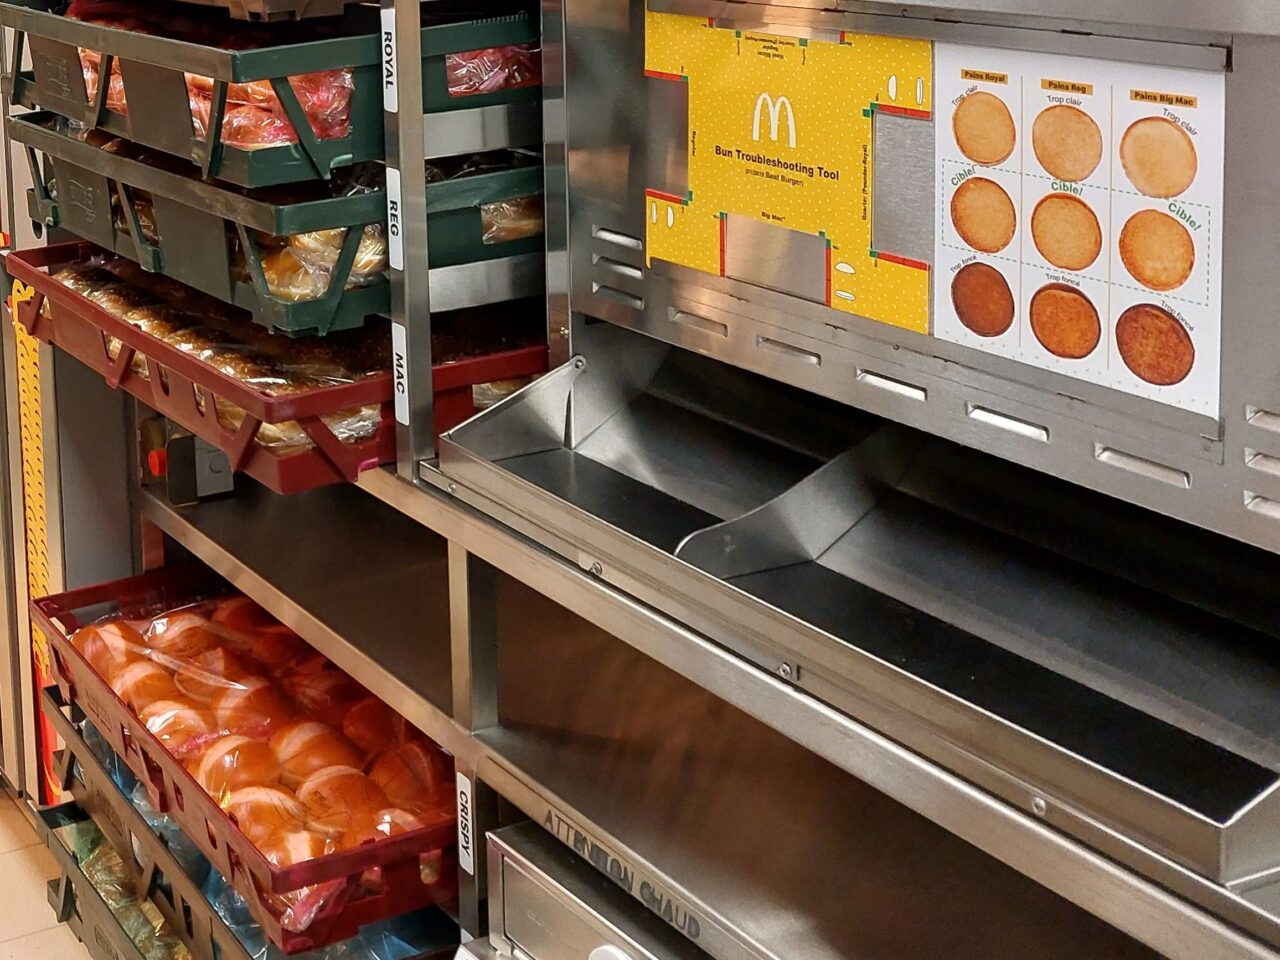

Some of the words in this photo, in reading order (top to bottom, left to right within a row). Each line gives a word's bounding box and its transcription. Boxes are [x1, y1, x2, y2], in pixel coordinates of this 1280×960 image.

[384, 31, 394, 90] ROYAL
[964, 70, 984, 80] Pains
[985, 73, 1005, 83] Royal
[1048, 81, 1070, 91] Pains
[1072, 84, 1086, 94] Reg
[951, 93, 965, 107] Trop
[965, 84, 978, 96] clair
[1047, 95, 1065, 105] Trop
[1065, 97, 1082, 107] clair
[1134, 91, 1158, 101] Pains
[1159, 94, 1174, 105] Big
[1175, 97, 1194, 106] Mac
[1162, 107, 1180, 123] Trop
[1180, 120, 1198, 136] clair
[714, 145, 733, 158] Bun
[736, 149, 814, 178] Troubleshooting
[817, 166, 840, 181] Tool
[951, 165, 976, 186] Cible!
[1051, 181, 1083, 196] Cible!
[389, 199, 399, 237] REG
[1168, 202, 1202, 231] Cible!
[1045, 273, 1060, 282] Trop
[395, 351, 405, 395] MAC
[459, 790, 471, 858] CRISPY
[544, 808, 635, 895] ATTENTION
[639, 880, 701, 940] CHAUD
